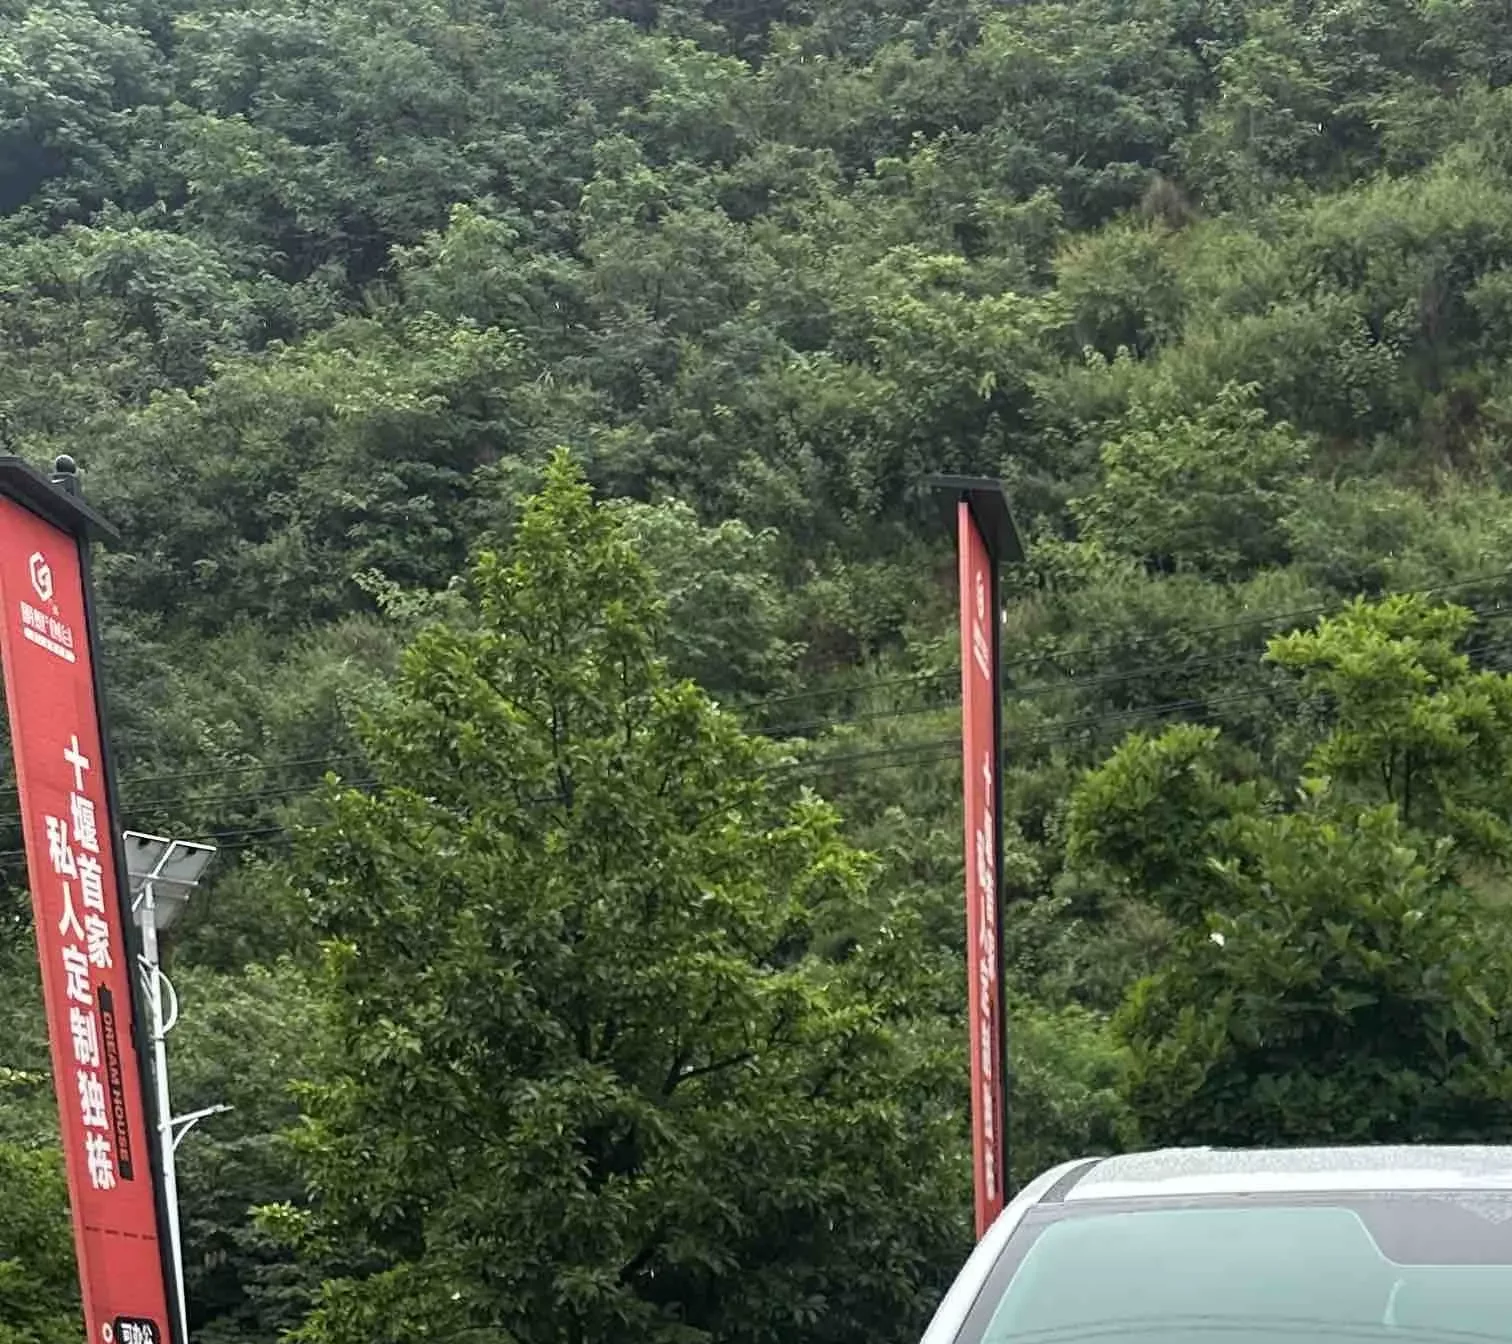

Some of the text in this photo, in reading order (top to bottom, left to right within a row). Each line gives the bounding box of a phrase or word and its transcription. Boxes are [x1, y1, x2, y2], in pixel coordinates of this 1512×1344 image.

[45, 815, 117, 1190] 私人定制独栋
[63, 734, 113, 969] 十堰首家
